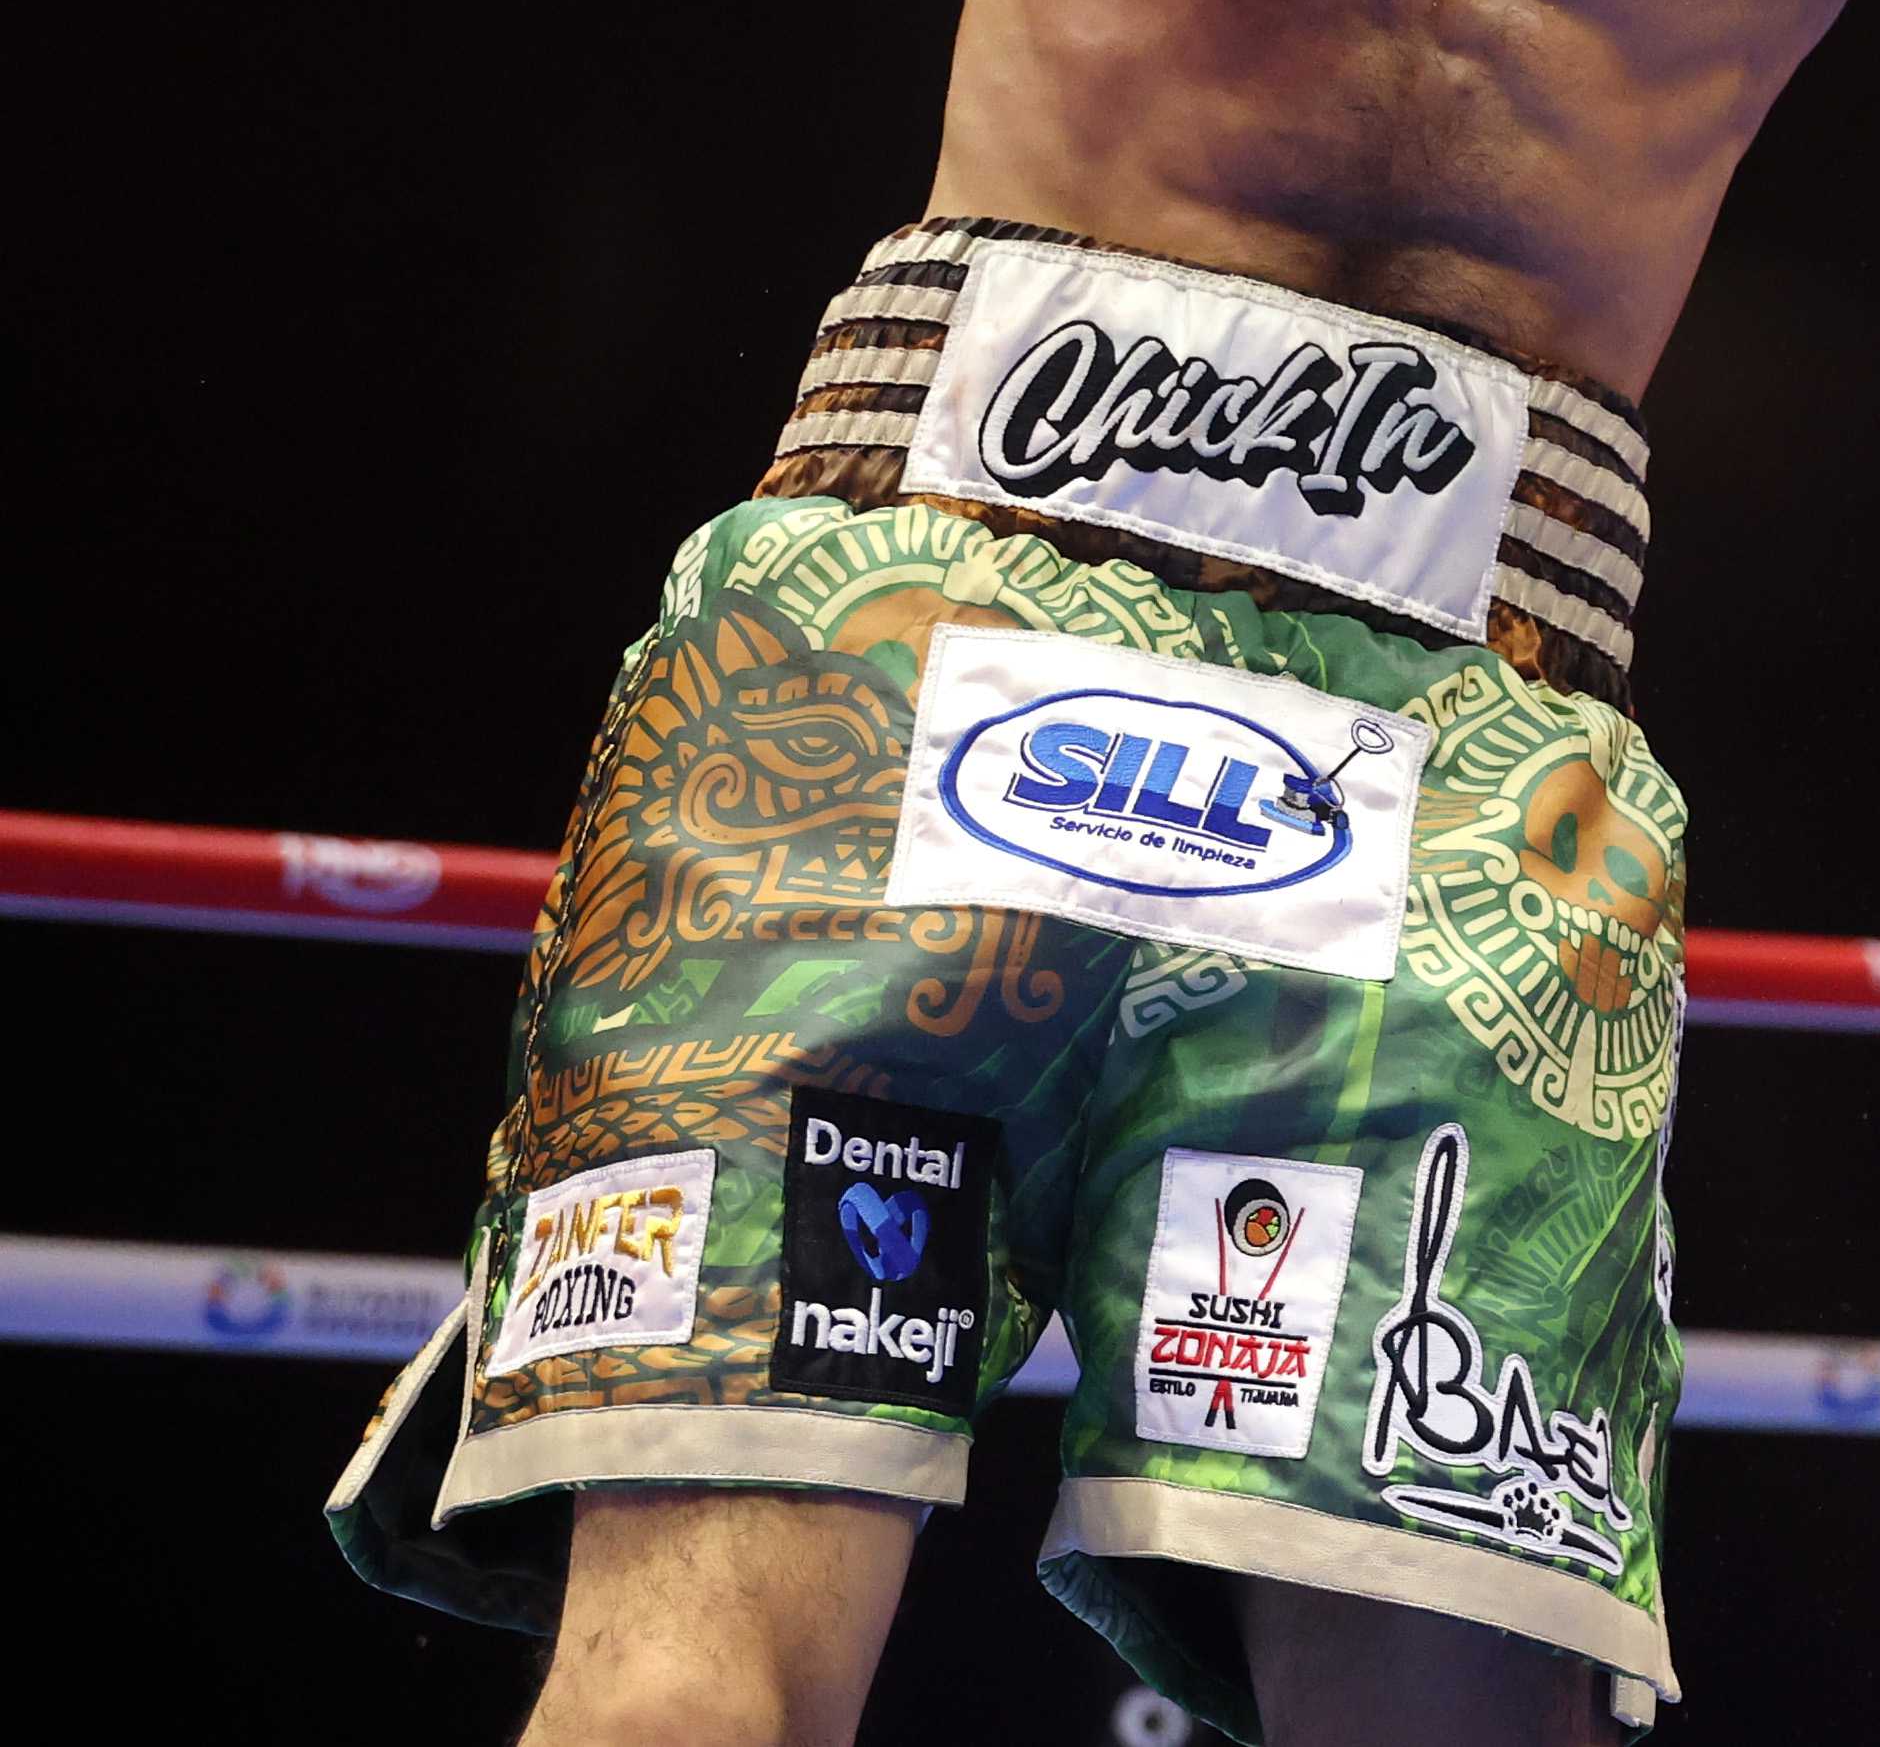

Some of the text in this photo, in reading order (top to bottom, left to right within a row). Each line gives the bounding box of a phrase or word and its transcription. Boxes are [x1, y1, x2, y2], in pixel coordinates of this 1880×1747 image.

[1005, 721, 1274, 851] SILL
[1049, 815, 1257, 870] Servicio de limpieza
[804, 1116, 966, 1190] Dental
[529, 1264, 636, 1340] BOXING
[1188, 1292, 1286, 1329] SUSHI
[1150, 1325, 1312, 1379] ZONAJA
